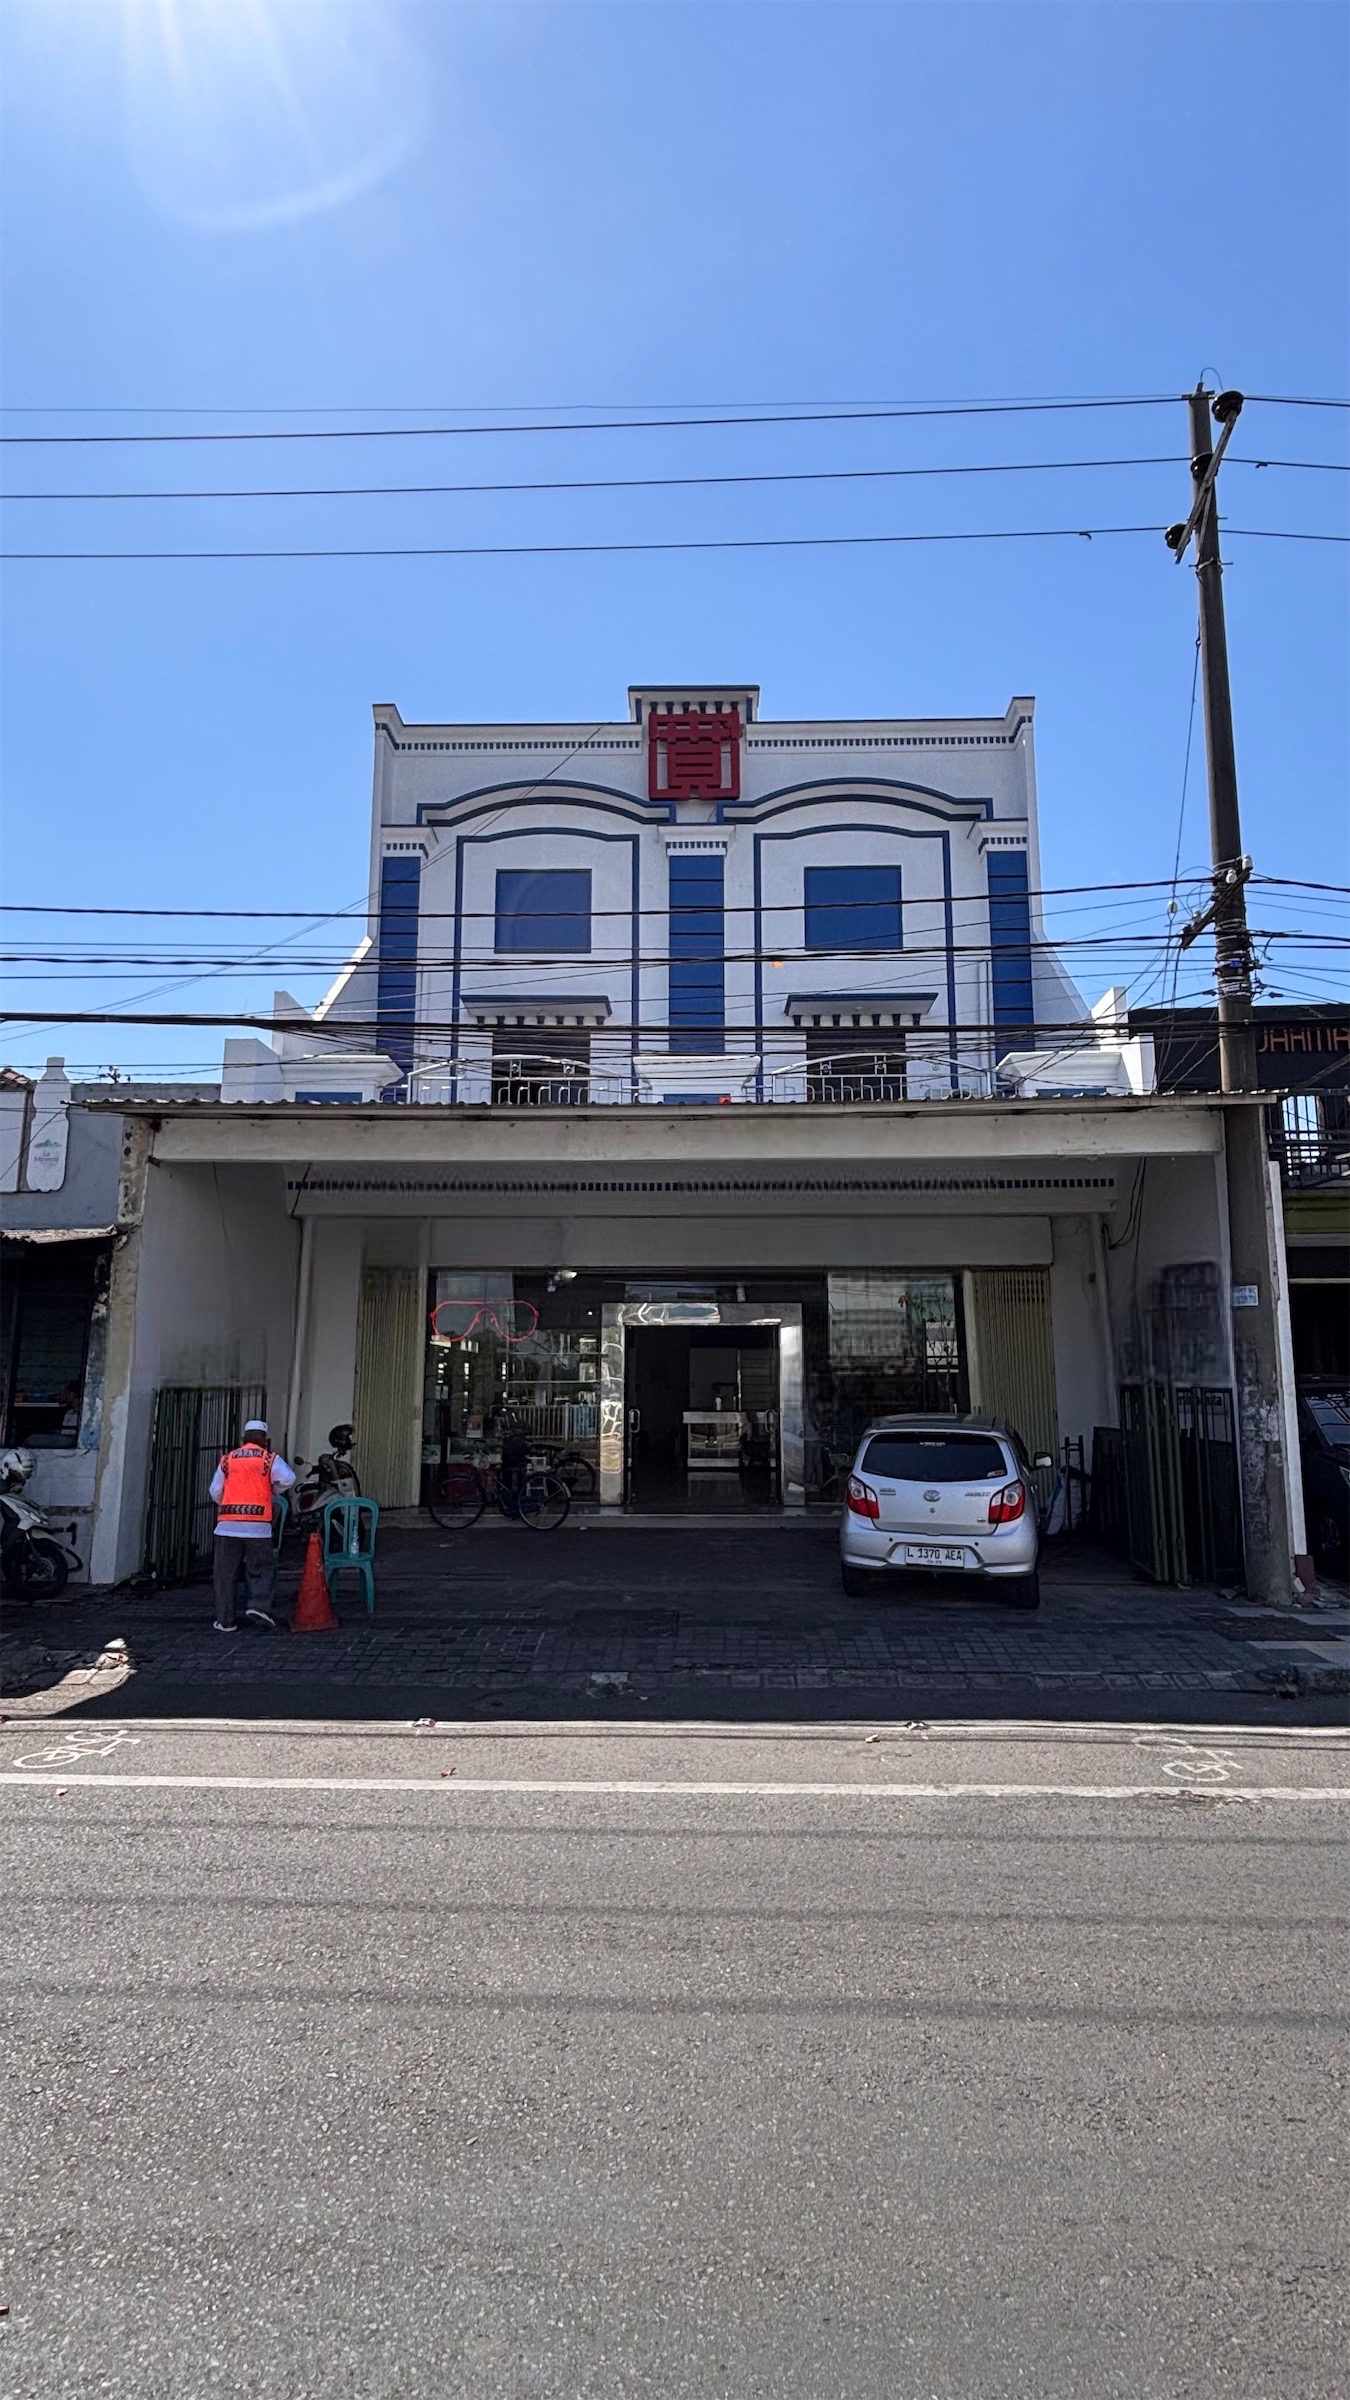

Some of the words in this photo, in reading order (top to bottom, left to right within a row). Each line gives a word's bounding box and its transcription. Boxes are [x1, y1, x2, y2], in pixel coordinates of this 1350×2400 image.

[907, 1547, 913, 1558] L
[918, 1548, 940, 1559] 1370
[945, 1549, 962, 1561] AEA
